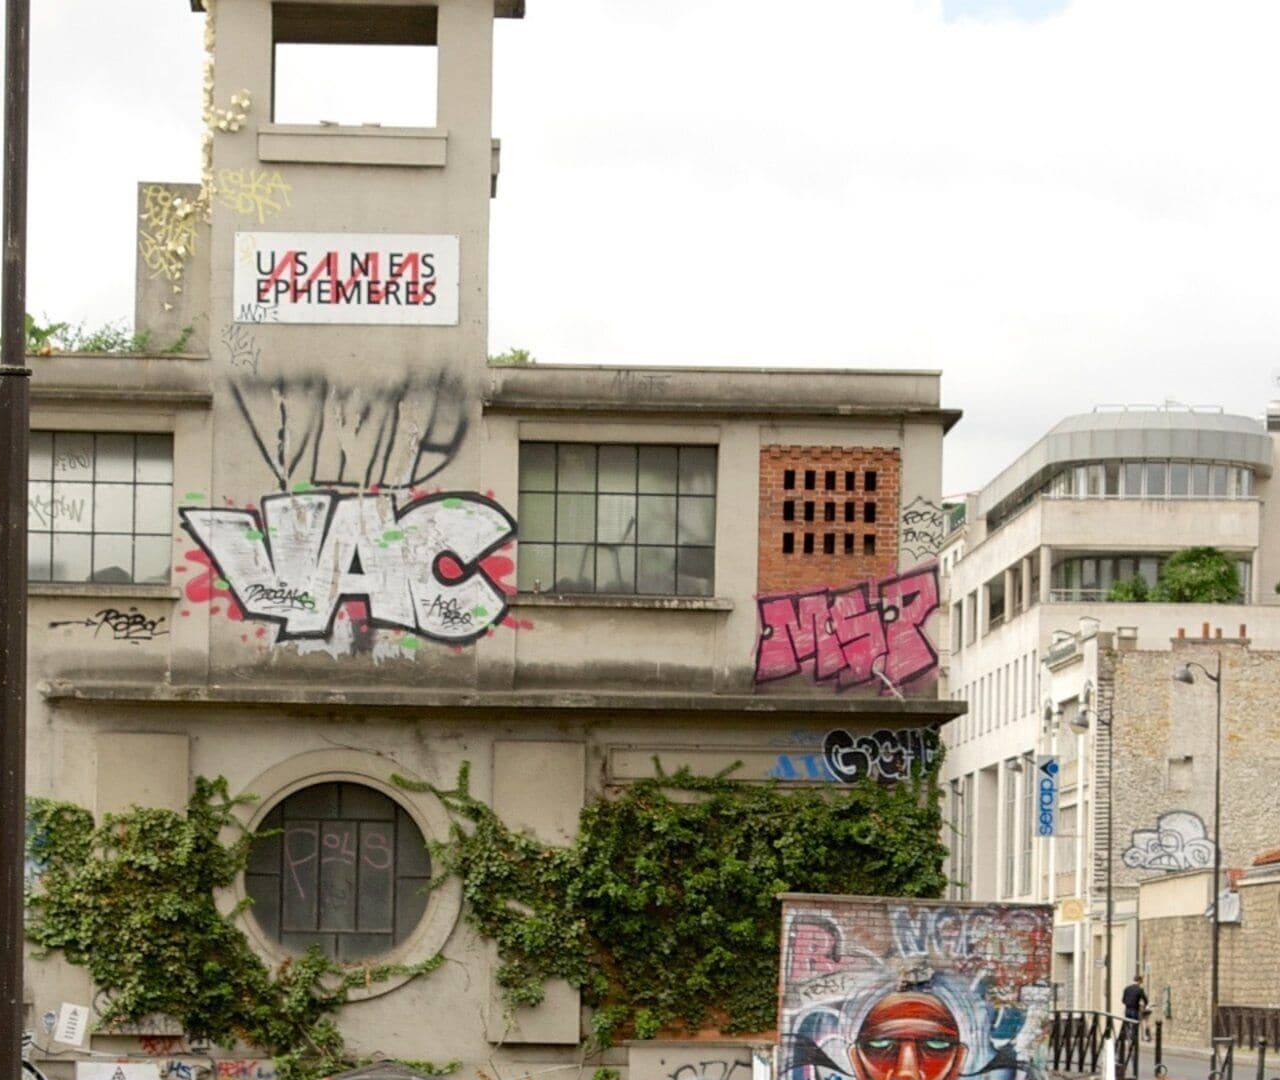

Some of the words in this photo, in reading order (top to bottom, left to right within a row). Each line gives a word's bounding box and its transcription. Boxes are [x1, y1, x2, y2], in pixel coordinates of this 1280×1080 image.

[257, 252, 435, 278] USINES
[257, 279, 437, 306] EPHEMERES
[1040, 778, 1058, 836] serap
